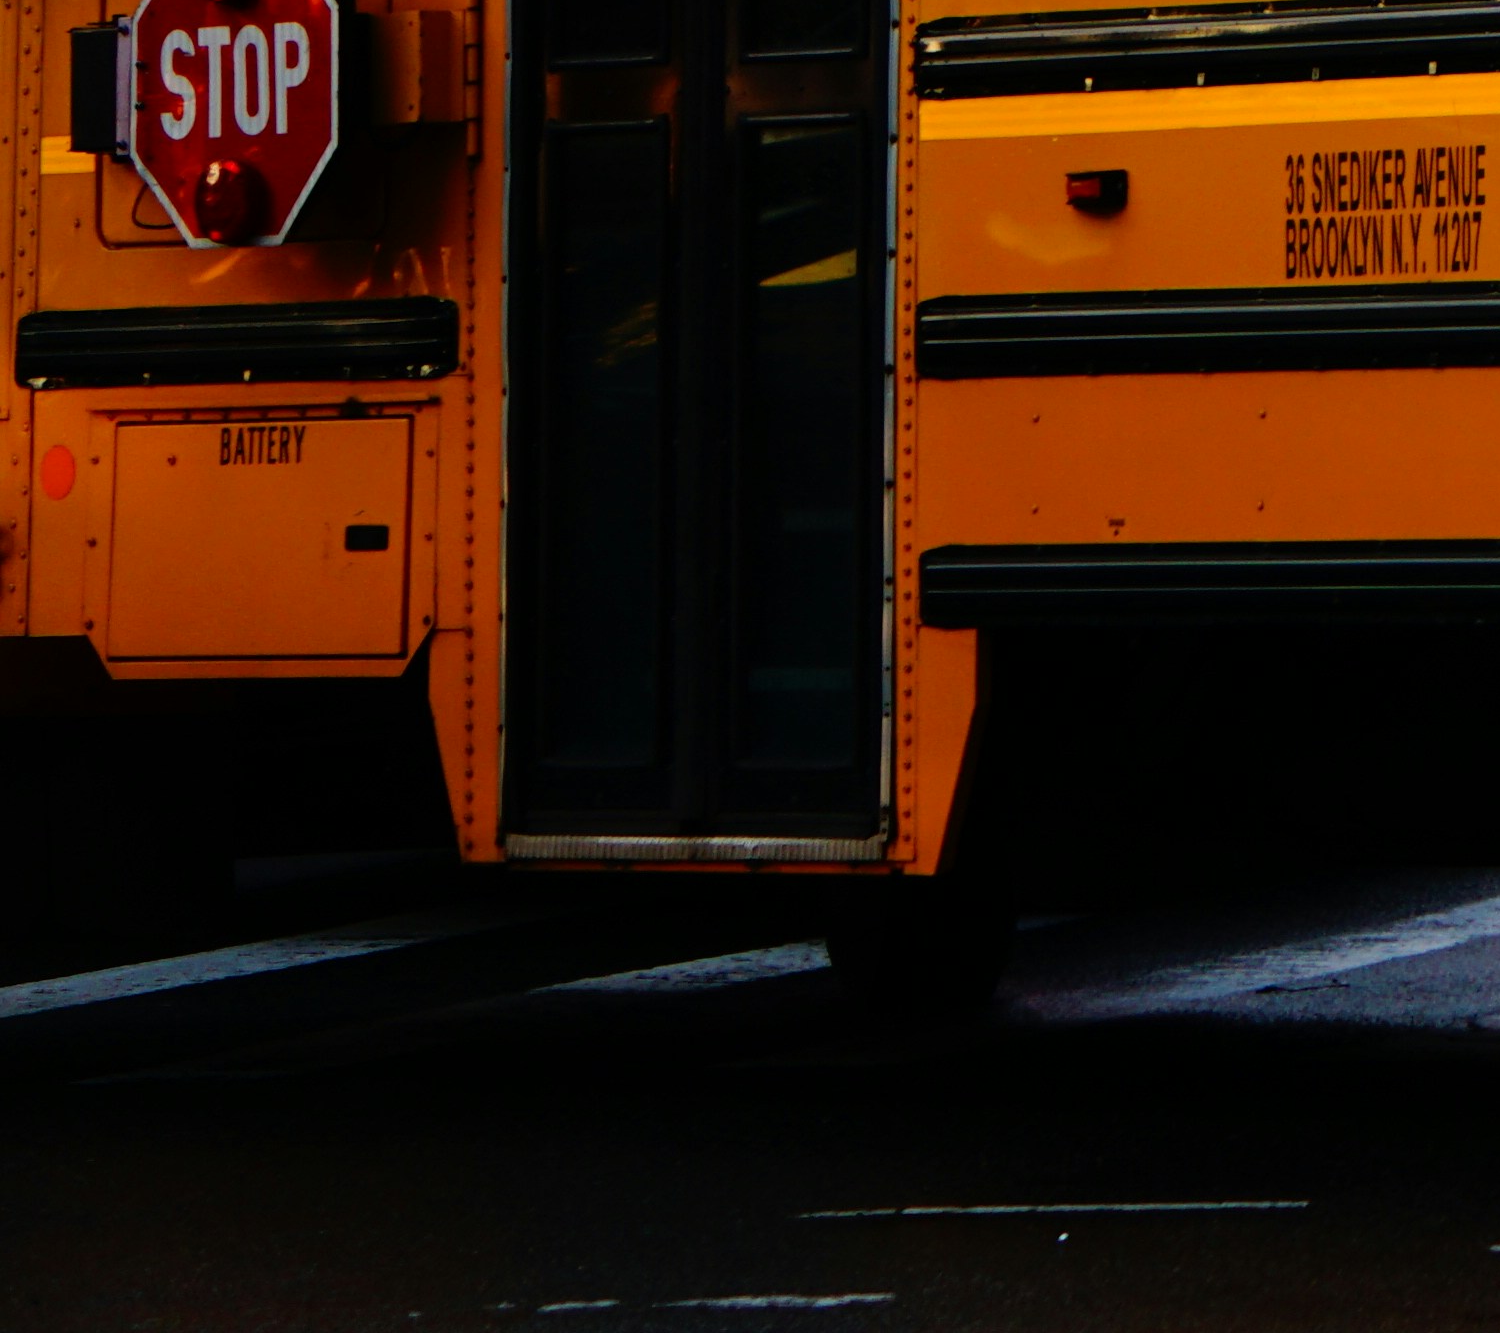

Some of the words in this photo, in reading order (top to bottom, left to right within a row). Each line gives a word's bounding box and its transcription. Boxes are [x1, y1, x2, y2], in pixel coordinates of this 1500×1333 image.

[160, 21, 310, 140] STOP
[1285, 154, 1305, 214] 36
[1312, 149, 1407, 213] SNEDIKER
[1412, 144, 1487, 208] AVENUE
[1285, 216, 1384, 279] BROOKLYN
[1391, 213, 1427, 274] N.Y.
[1434, 211, 1482, 272] 11207
[219, 425, 307, 466] BATTERY
